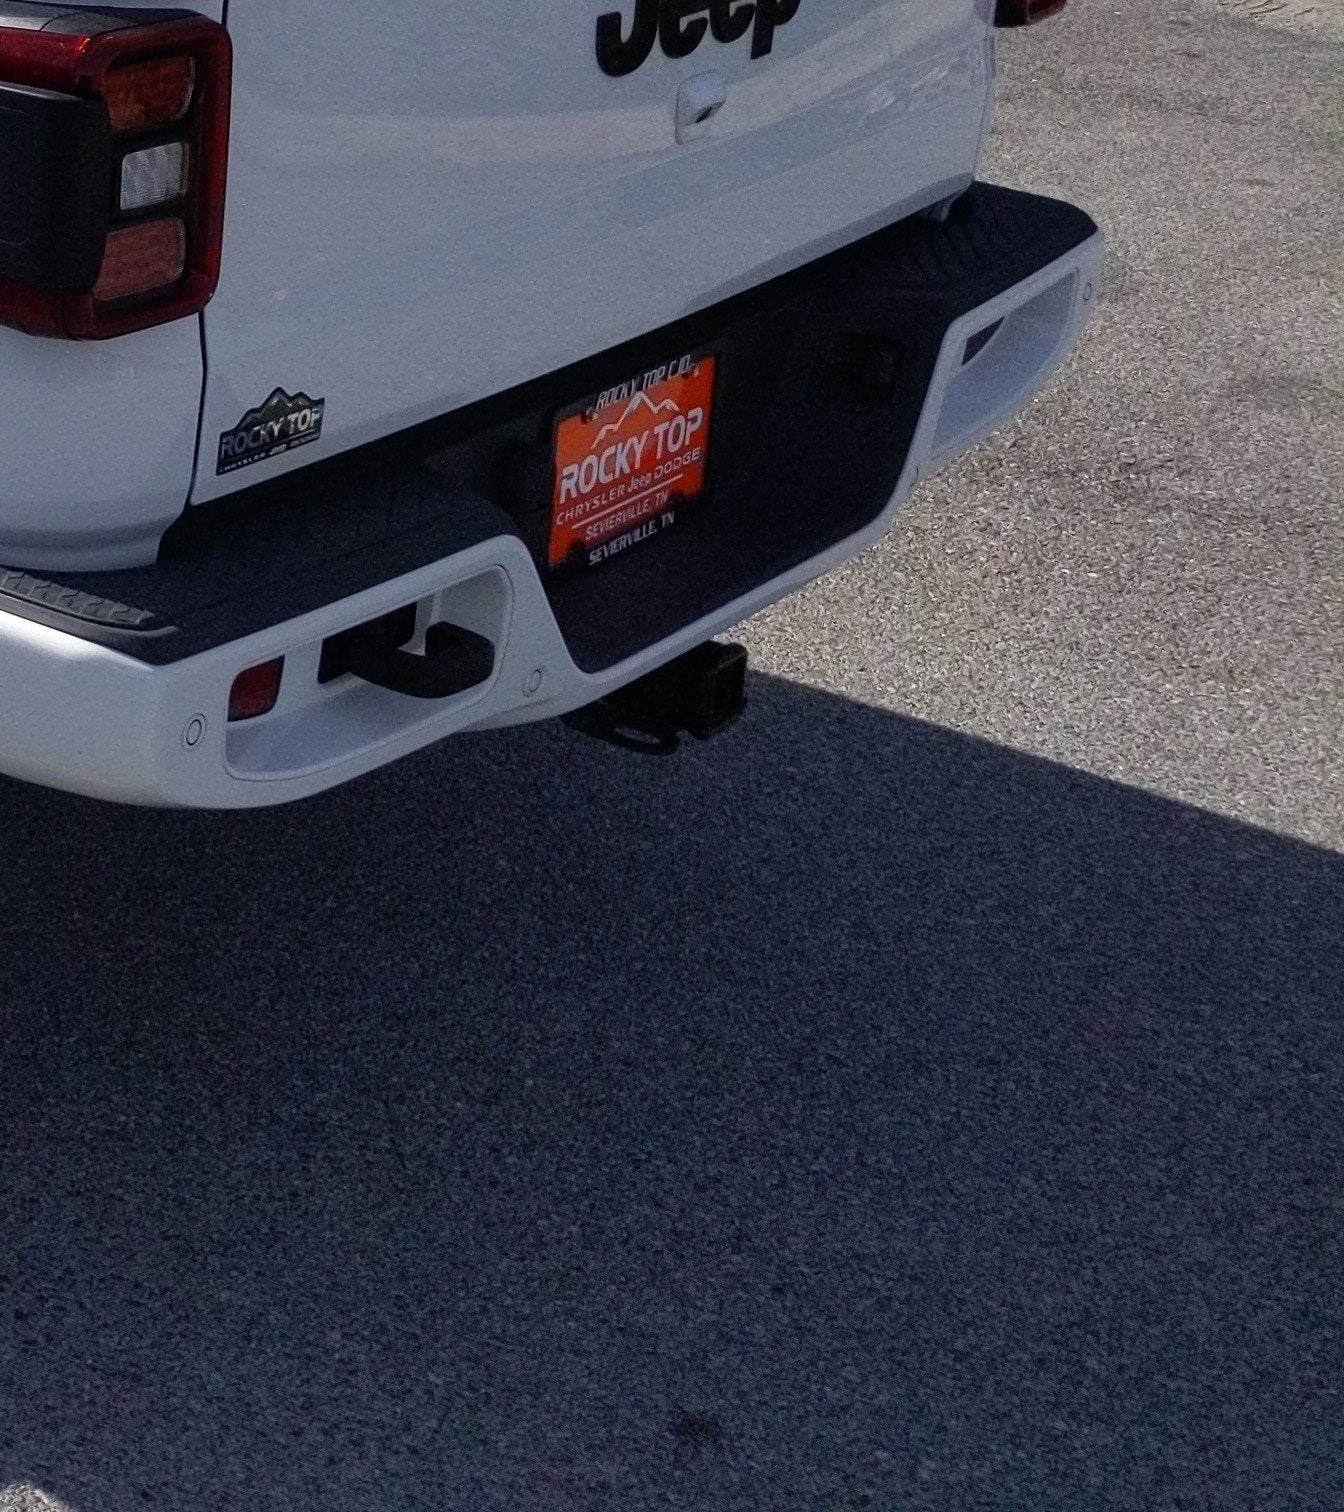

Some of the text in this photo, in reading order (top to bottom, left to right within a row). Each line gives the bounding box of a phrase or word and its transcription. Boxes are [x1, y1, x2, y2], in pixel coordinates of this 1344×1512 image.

[221, 408, 321, 460] ROCKY TOP
[560, 407, 703, 504] ROCKY TOP
[557, 484, 625, 525] CHRYSLER
[653, 447, 702, 479] DODGE
[655, 490, 669, 507] TN
[661, 510, 676, 529] TN
